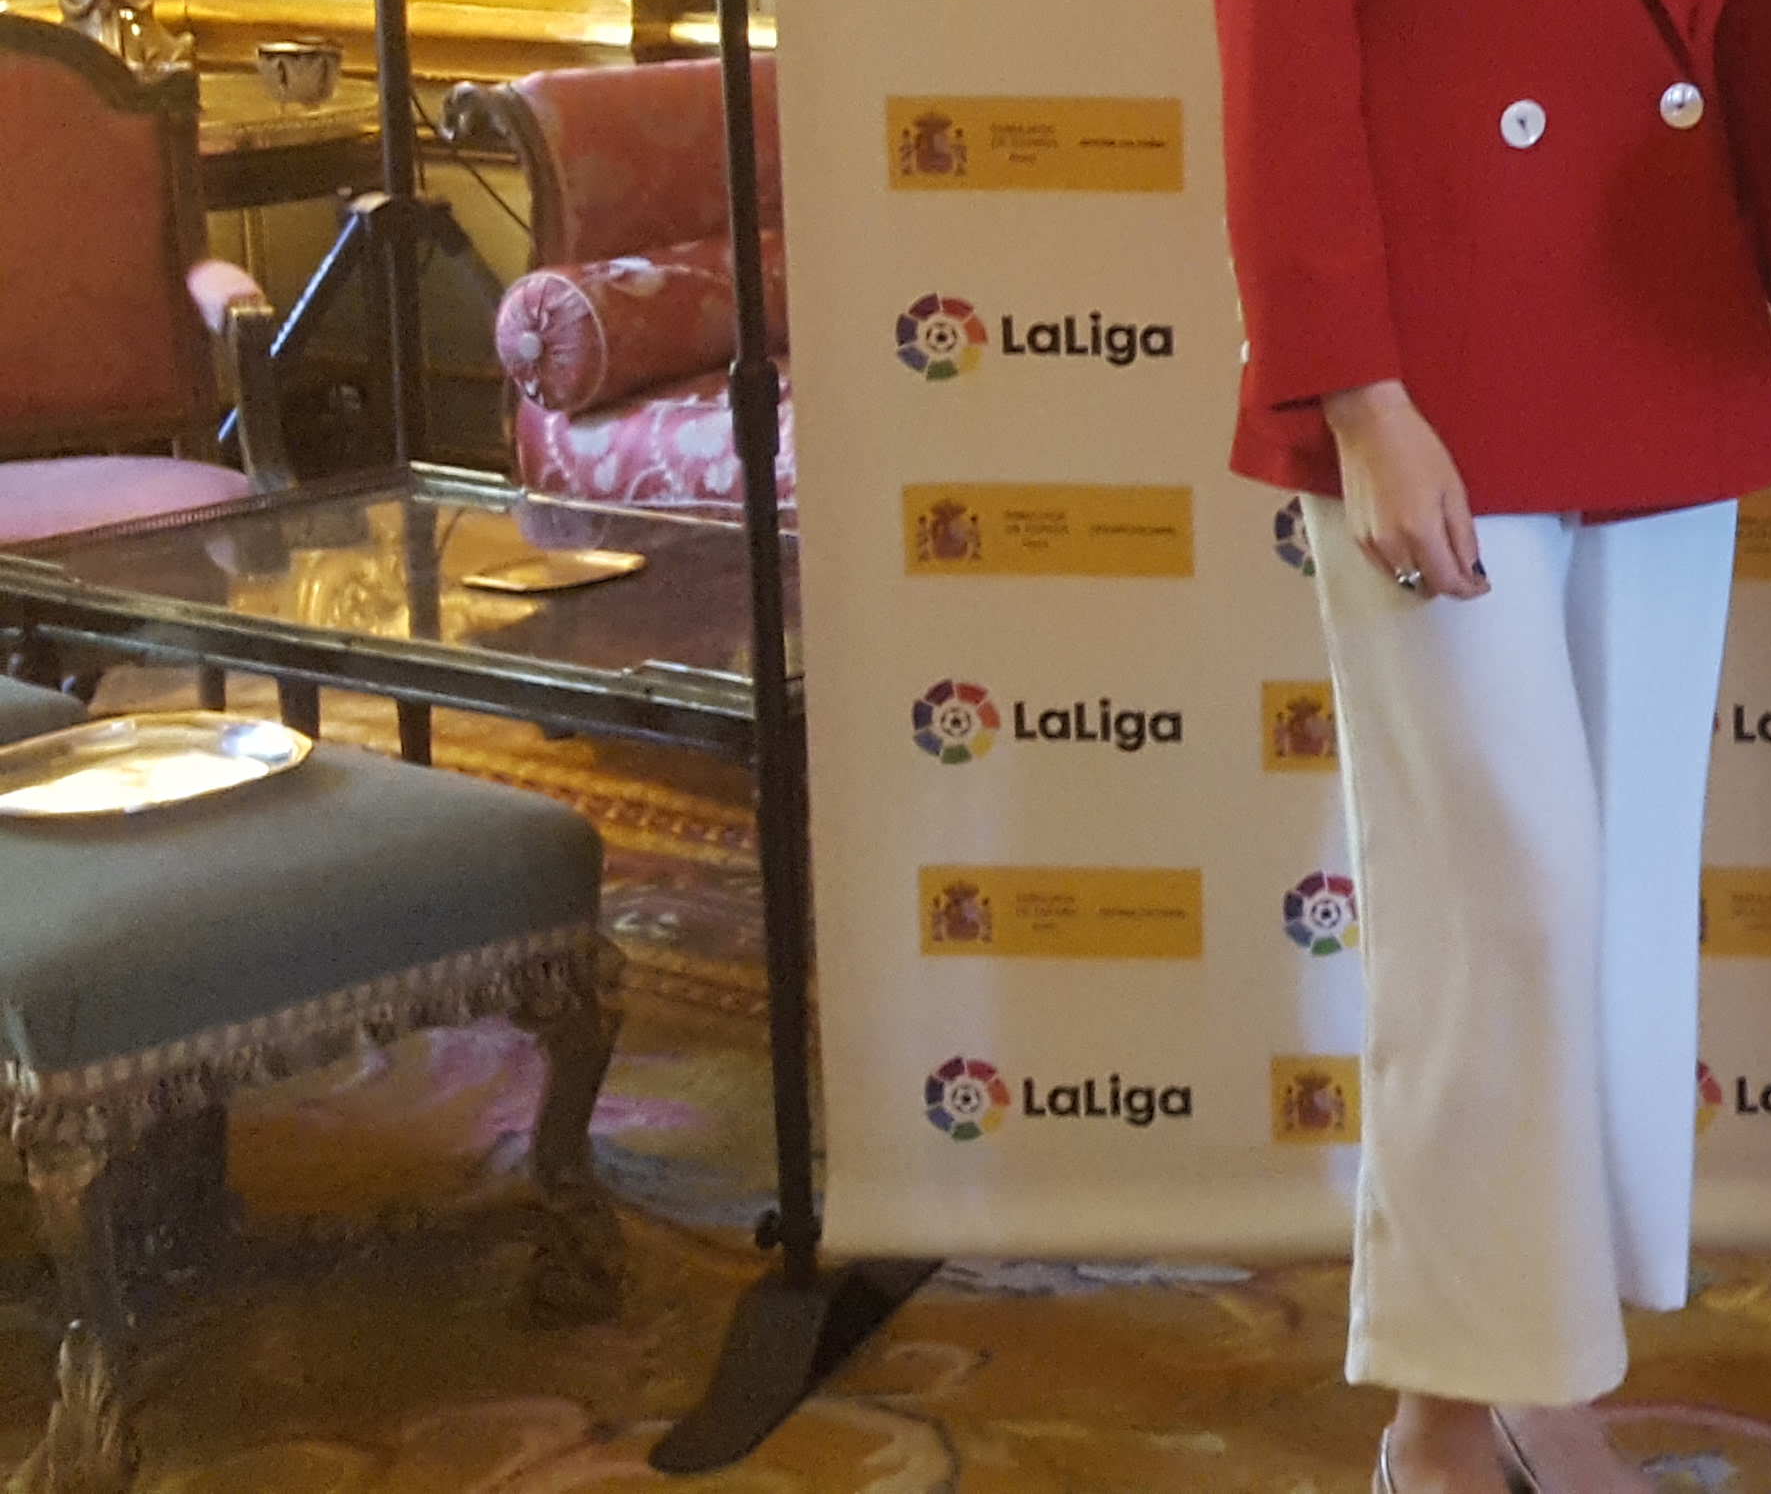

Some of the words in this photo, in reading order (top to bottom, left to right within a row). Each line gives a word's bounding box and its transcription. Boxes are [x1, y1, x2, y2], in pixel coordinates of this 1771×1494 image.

[1001, 312, 1173, 367] LaLiga
[1014, 698, 1182, 753] LaLiga
[1023, 1074, 1192, 1127] LaLiga
